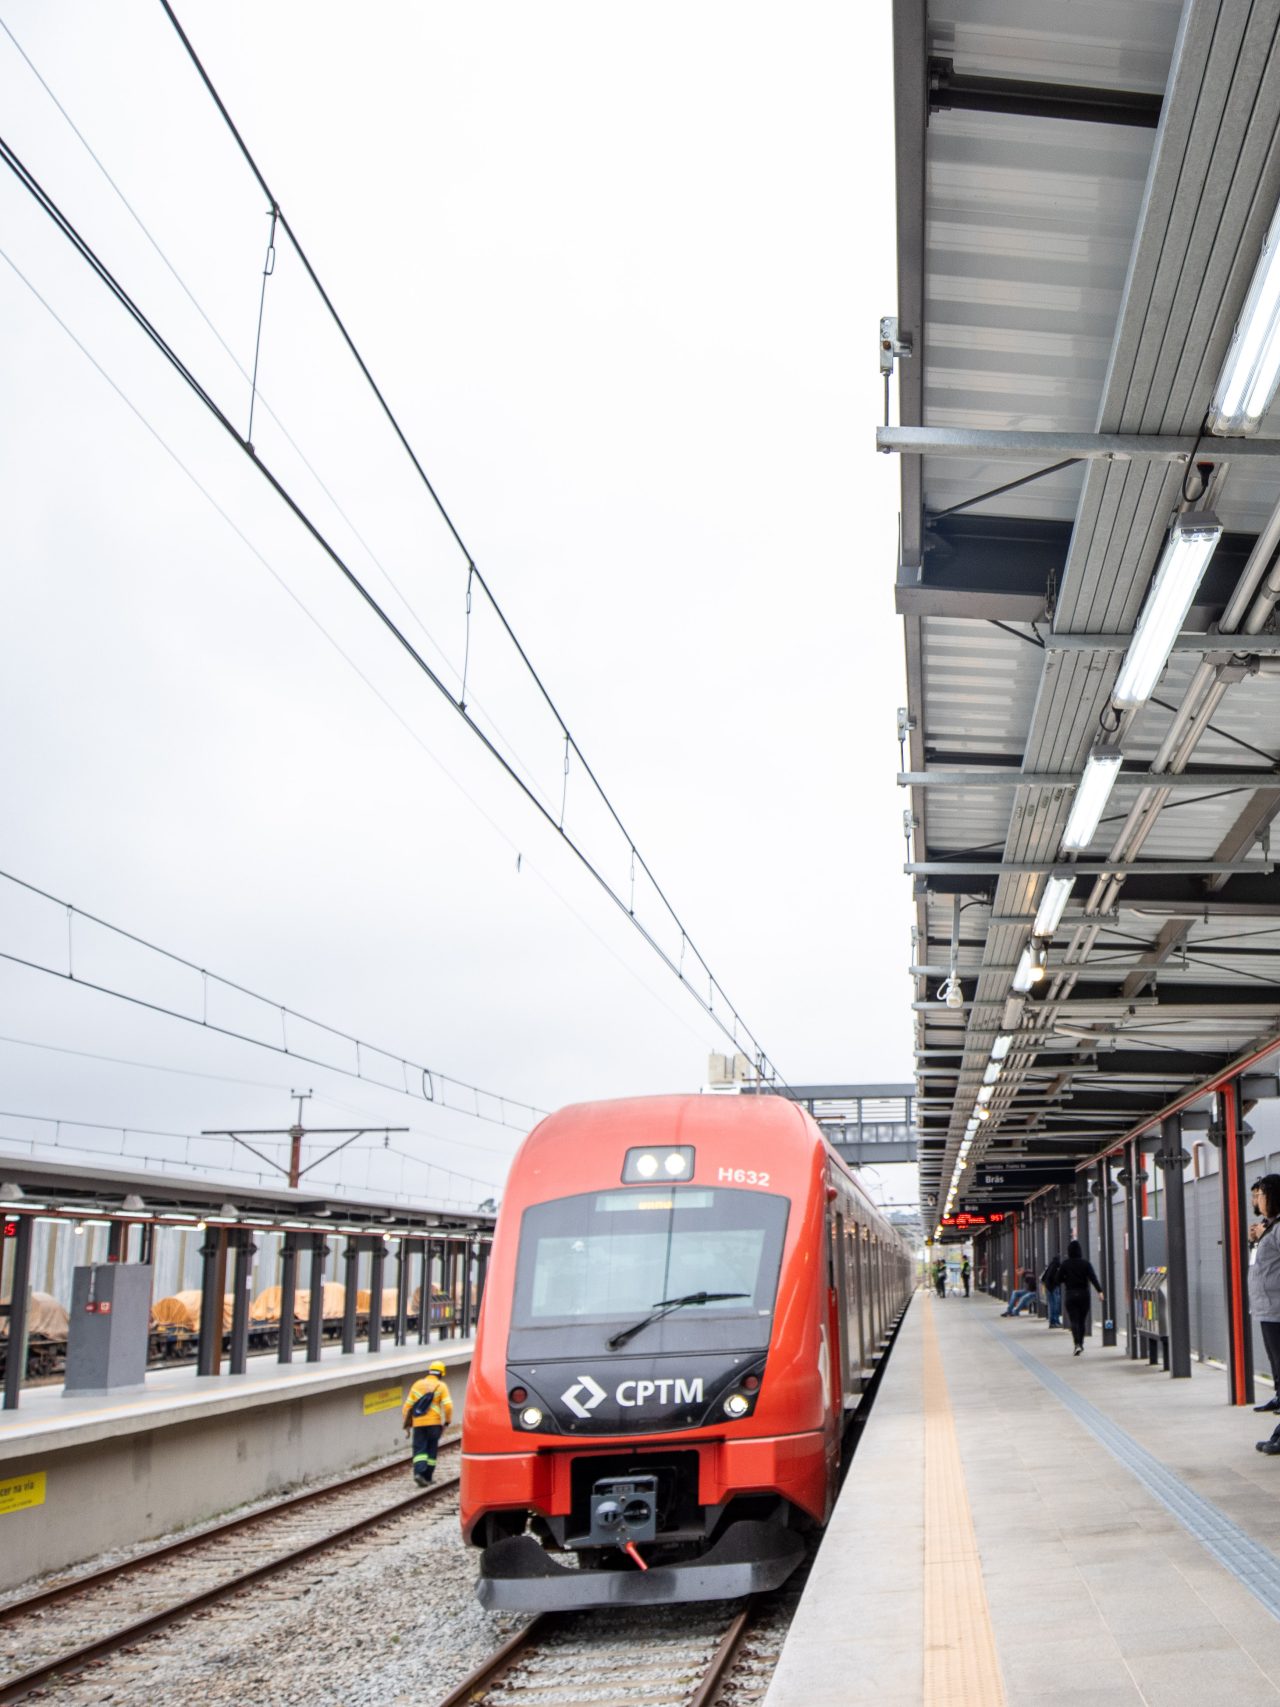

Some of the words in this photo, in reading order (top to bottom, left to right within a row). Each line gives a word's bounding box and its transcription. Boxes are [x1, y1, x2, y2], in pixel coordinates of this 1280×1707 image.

[718, 1167, 770, 1187] H632
[985, 1175, 1004, 1184] Brás
[616, 1378, 703, 1407] CPTM
